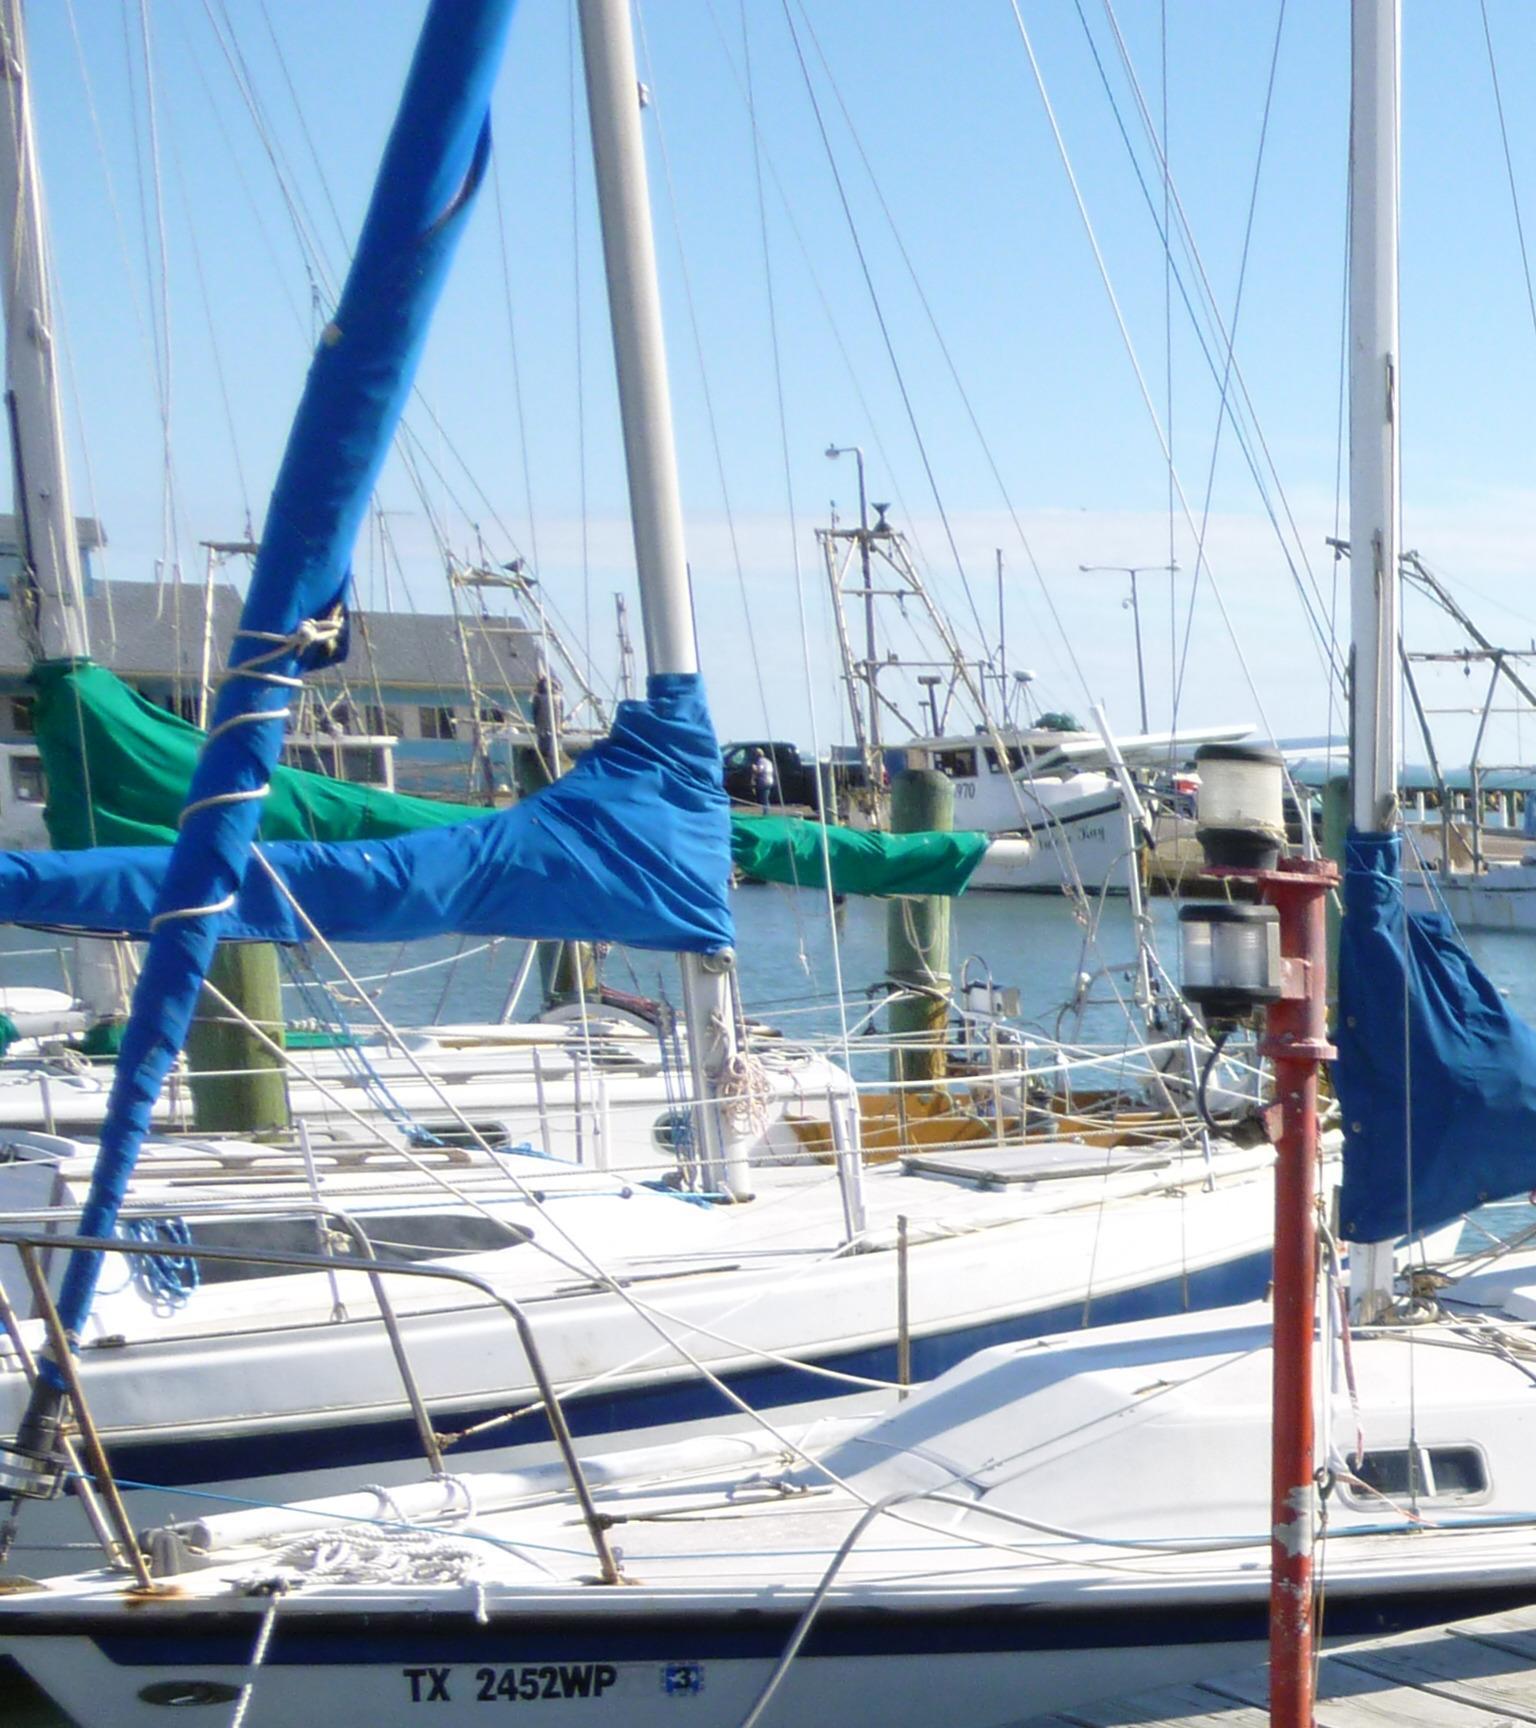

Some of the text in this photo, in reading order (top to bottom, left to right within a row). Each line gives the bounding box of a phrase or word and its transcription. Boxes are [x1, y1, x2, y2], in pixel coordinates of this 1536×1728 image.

[403, 1664, 617, 1702] TX 2452WP
[674, 1666, 692, 1688] 3
